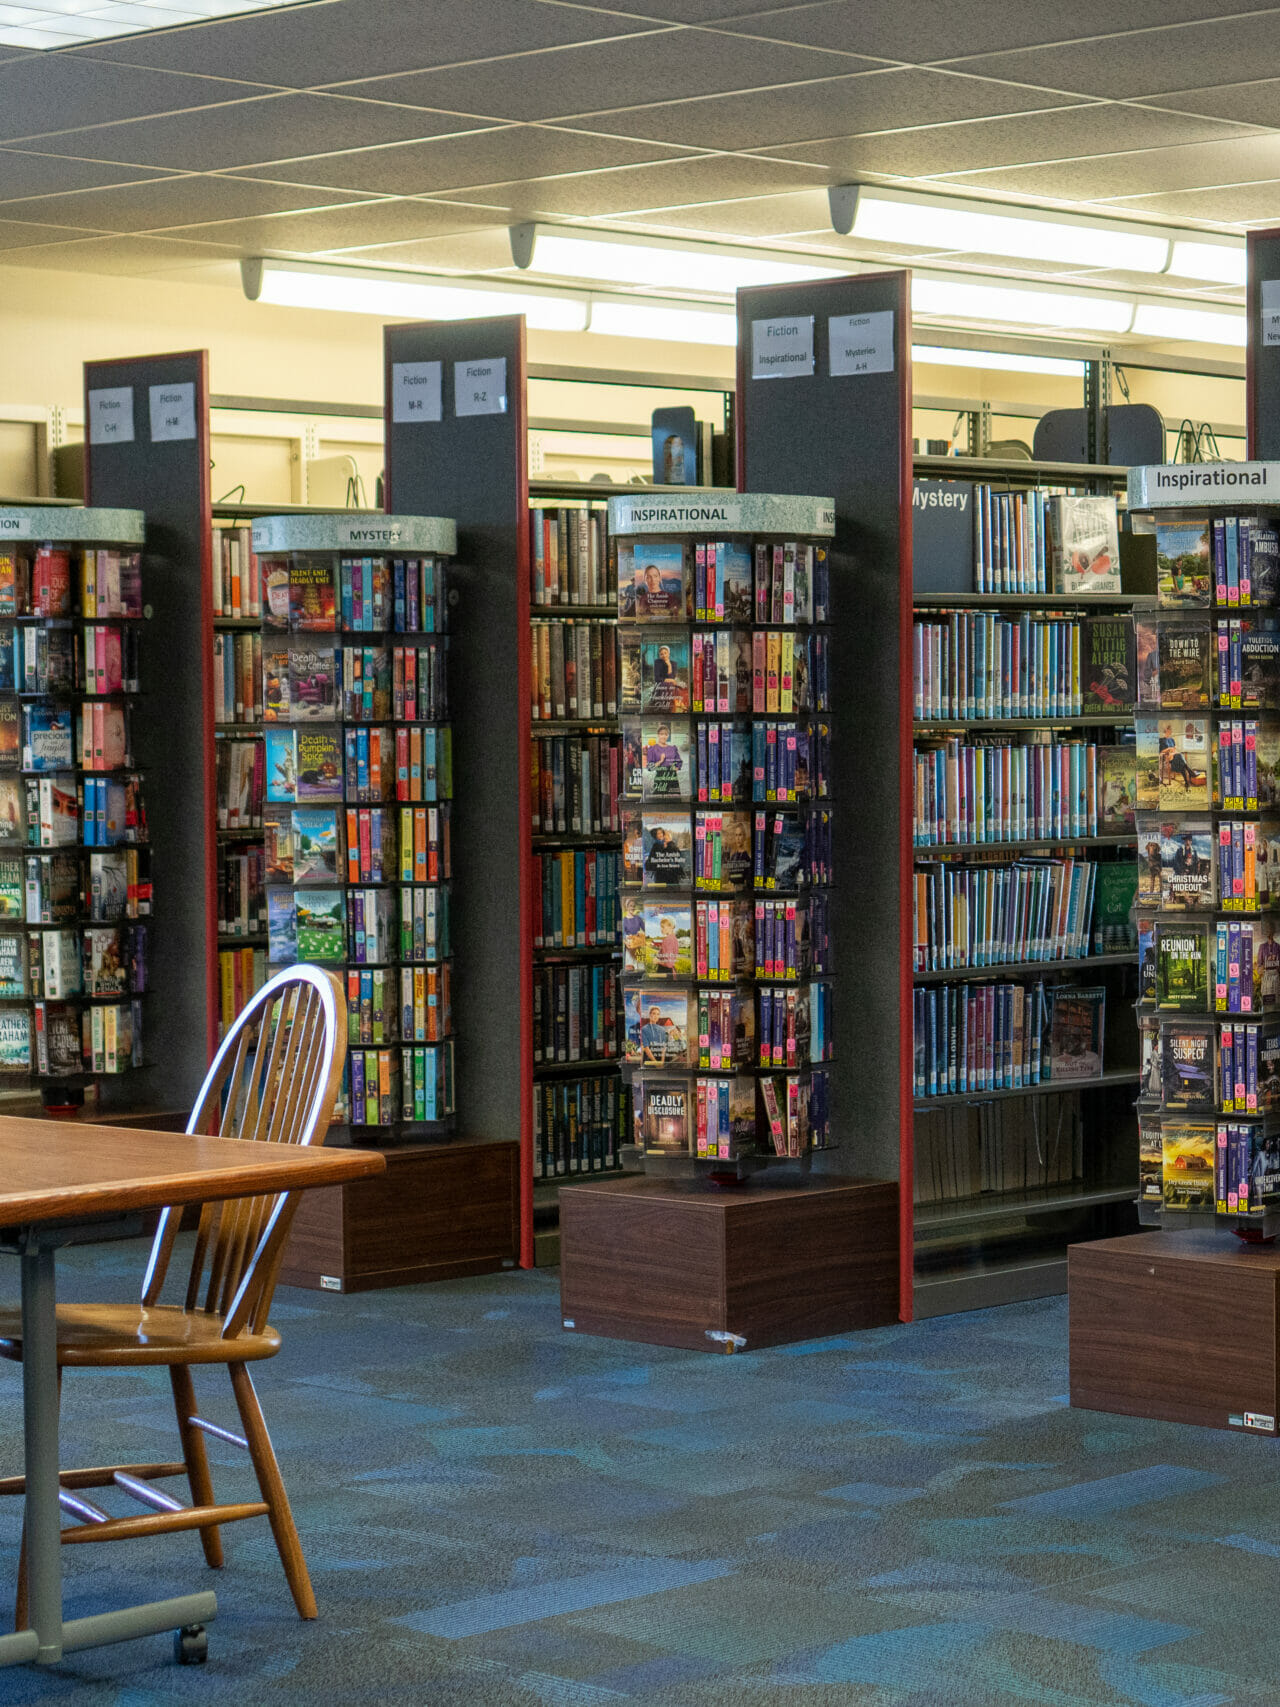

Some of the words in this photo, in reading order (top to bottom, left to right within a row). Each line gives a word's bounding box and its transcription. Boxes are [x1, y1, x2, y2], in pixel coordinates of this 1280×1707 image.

[849, 318, 870, 326] Fiction
[767, 325, 798, 337] Fiction
[845, 347, 876, 358] Mysteries
[759, 352, 807, 366] Inspirational
[466, 367, 492, 376] Fiction
[403, 376, 428, 385] Fiction
[160, 394, 182, 404] Fiction
[473, 392, 487, 402] R-Z
[99, 400, 120, 410] Fiction
[408, 400, 422, 410] M-R
[104, 424, 116, 432] C-H
[1156, 468, 1267, 490] Inspirational
[631, 508, 728, 522] INSPIRATIONAL
[0, 520, 20, 529] ION
[350, 530, 402, 541] MYSTERY
[1092, 624, 1125, 637] SUSAN
[1092, 638, 1126, 650] WITTIG
[1169, 640, 1188, 649] DOWN
[1242, 644, 1279, 654] ABDUCTION
[292, 652, 316, 662] Death
[1092, 652, 1127, 664] ALBERT
[1169, 648, 1181, 658] THE
[1183, 648, 1200, 658] WIRE
[307, 662, 330, 670] Coffee
[301, 735, 328, 744] Death
[298, 744, 334, 753] Pumpkin
[301, 752, 324, 762] Spice
[0, 862, 20, 872] THER
[1167, 874, 1208, 883] CHRISTMAS
[1172, 883, 1202, 892] HIDEOUT
[1160, 940, 1194, 951] REUNION
[1170, 951, 1178, 960] ON
[1178, 951, 1188, 960] THE
[0, 1020, 26, 1028] ATHER
[0, 1031, 28, 1041] RAHAM
[1170, 1039, 1189, 1048] SILENT
[1190, 1039, 1208, 1048] NIGHT
[1172, 1048, 1205, 1060] SUSPECT
[650, 1094, 682, 1107] DEADLY
[648, 1106, 684, 1116] DISCLOSURE
